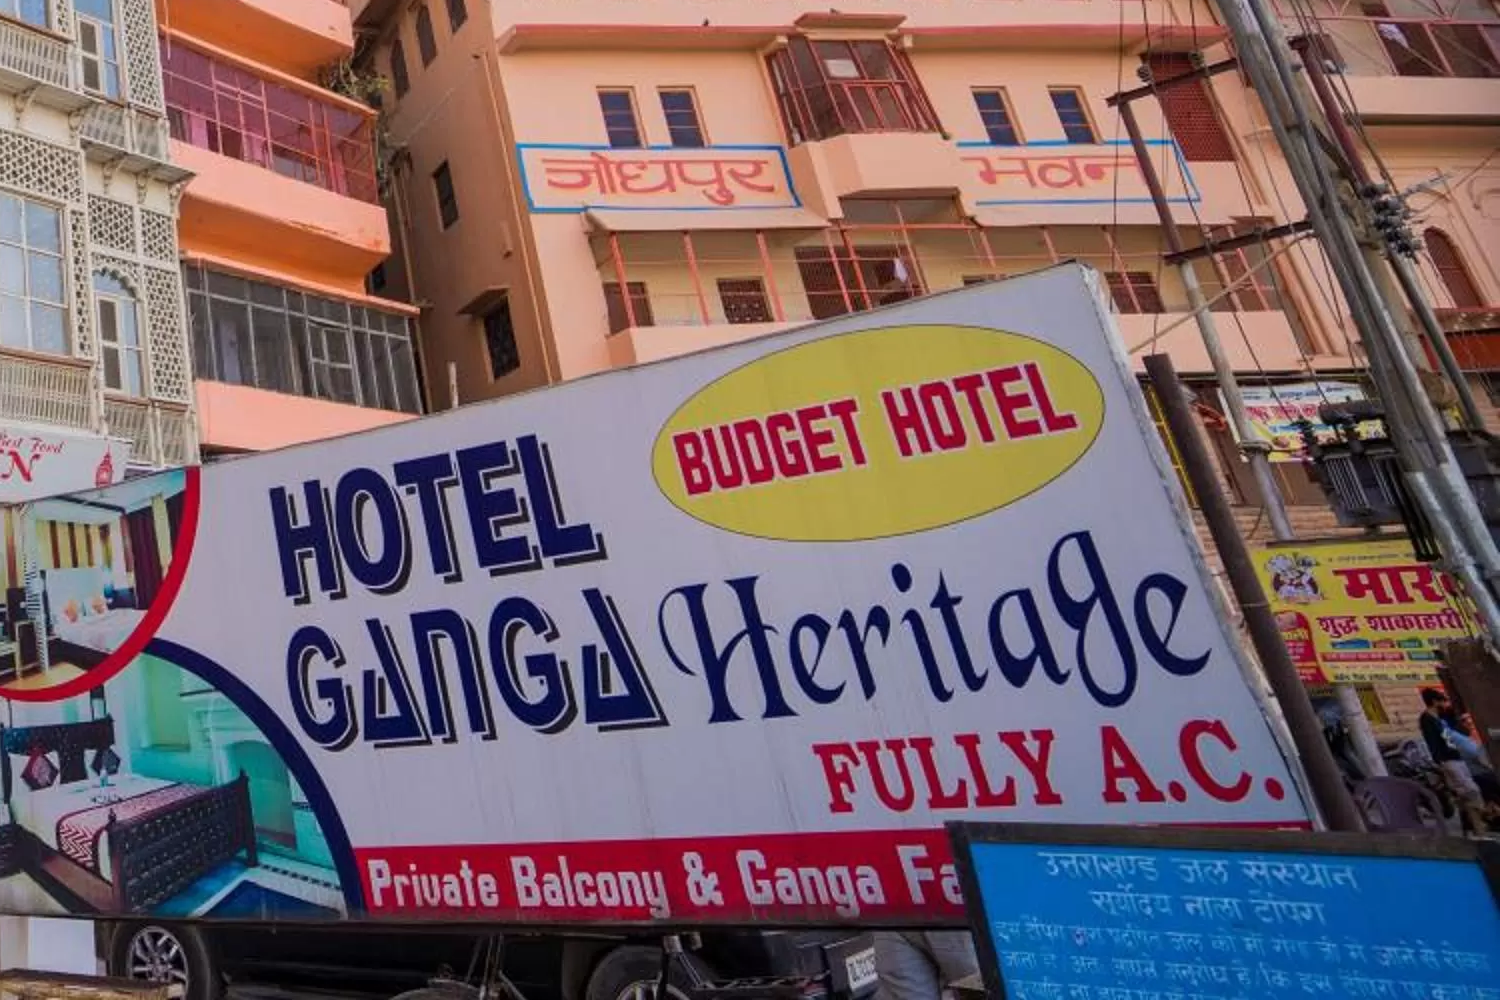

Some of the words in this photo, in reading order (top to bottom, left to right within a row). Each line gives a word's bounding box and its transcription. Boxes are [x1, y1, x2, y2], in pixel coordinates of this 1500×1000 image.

[541, 151, 776, 206] जोधपुर
[673, 398, 867, 495] BUDGET
[881, 362, 1078, 459] HOTEL
[269, 434, 607, 606] HOTEL
[286, 588, 669, 751] GANGA
[658, 530, 1212, 724] Heritage
[812, 729, 1063, 813] FULLY
[1101, 719, 1285, 803] A.C.
[368, 859, 499, 909] Private
[510, 855, 671, 919] Balcony
[682, 851, 722, 906] &
[736, 848, 886, 916] Ganga
[897, 844, 964, 905] Fa
[1170, 857, 1229, 885] जल
[1179, 895, 1244, 921] नाला
